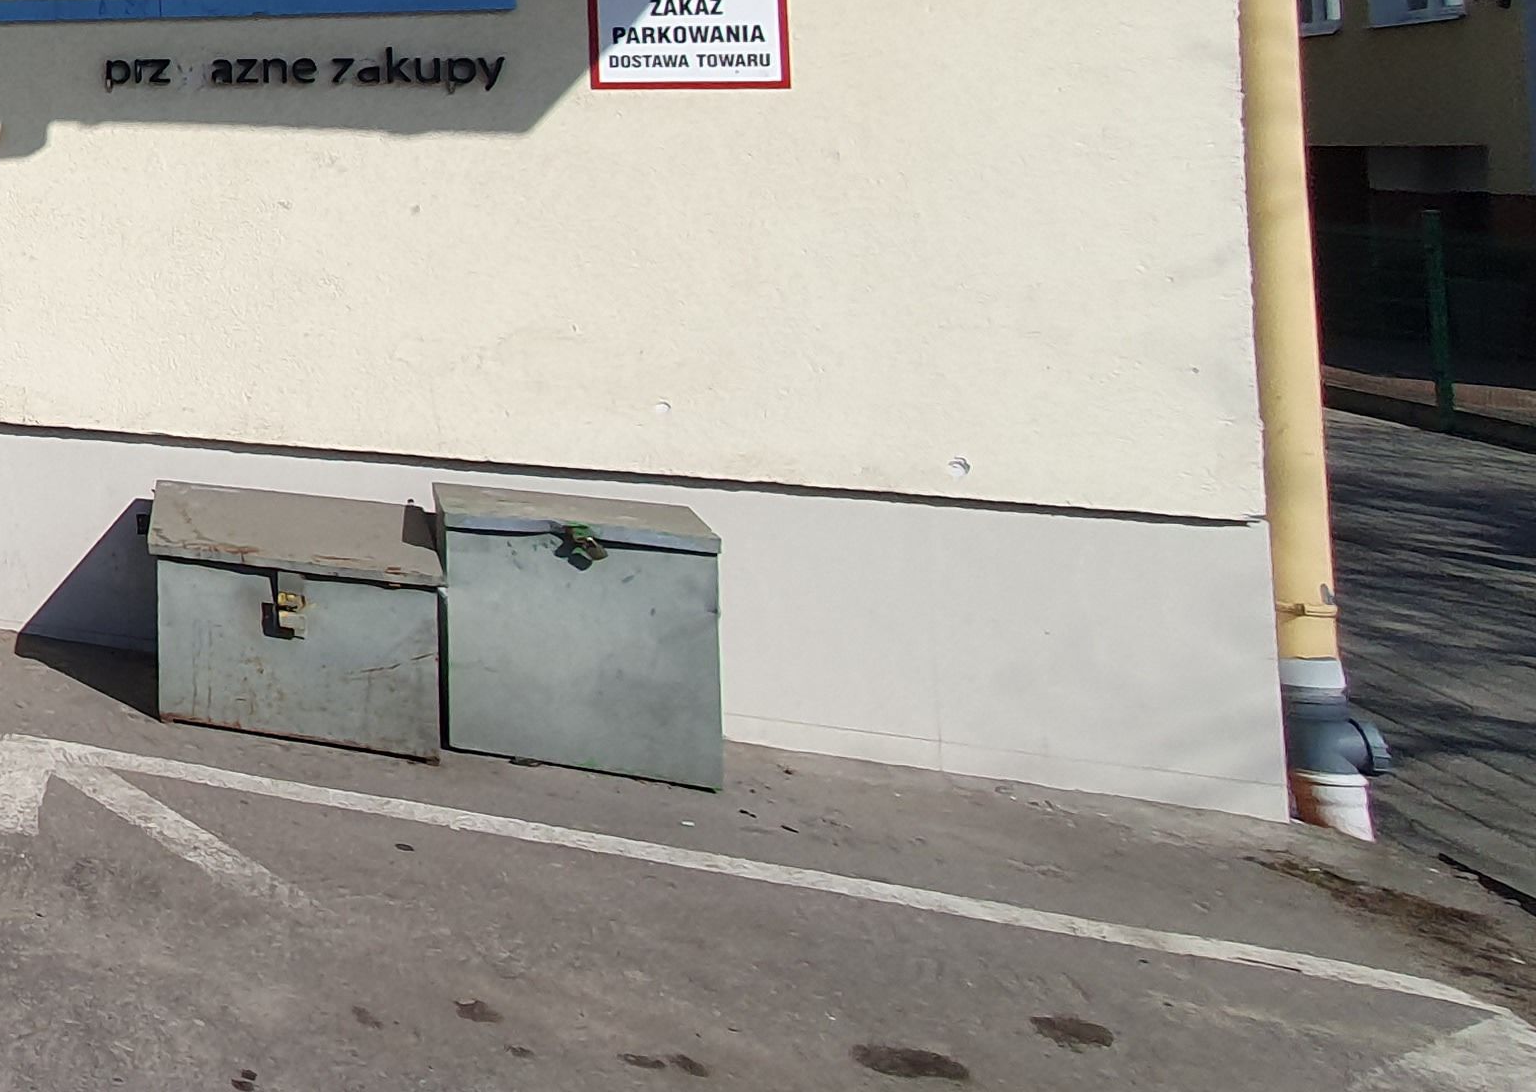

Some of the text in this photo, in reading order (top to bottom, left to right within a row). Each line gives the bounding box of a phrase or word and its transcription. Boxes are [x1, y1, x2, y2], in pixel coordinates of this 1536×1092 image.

[612, 24, 766, 45] PARKOWANIA
[609, 52, 771, 69] DOSTAWA TOWARU
